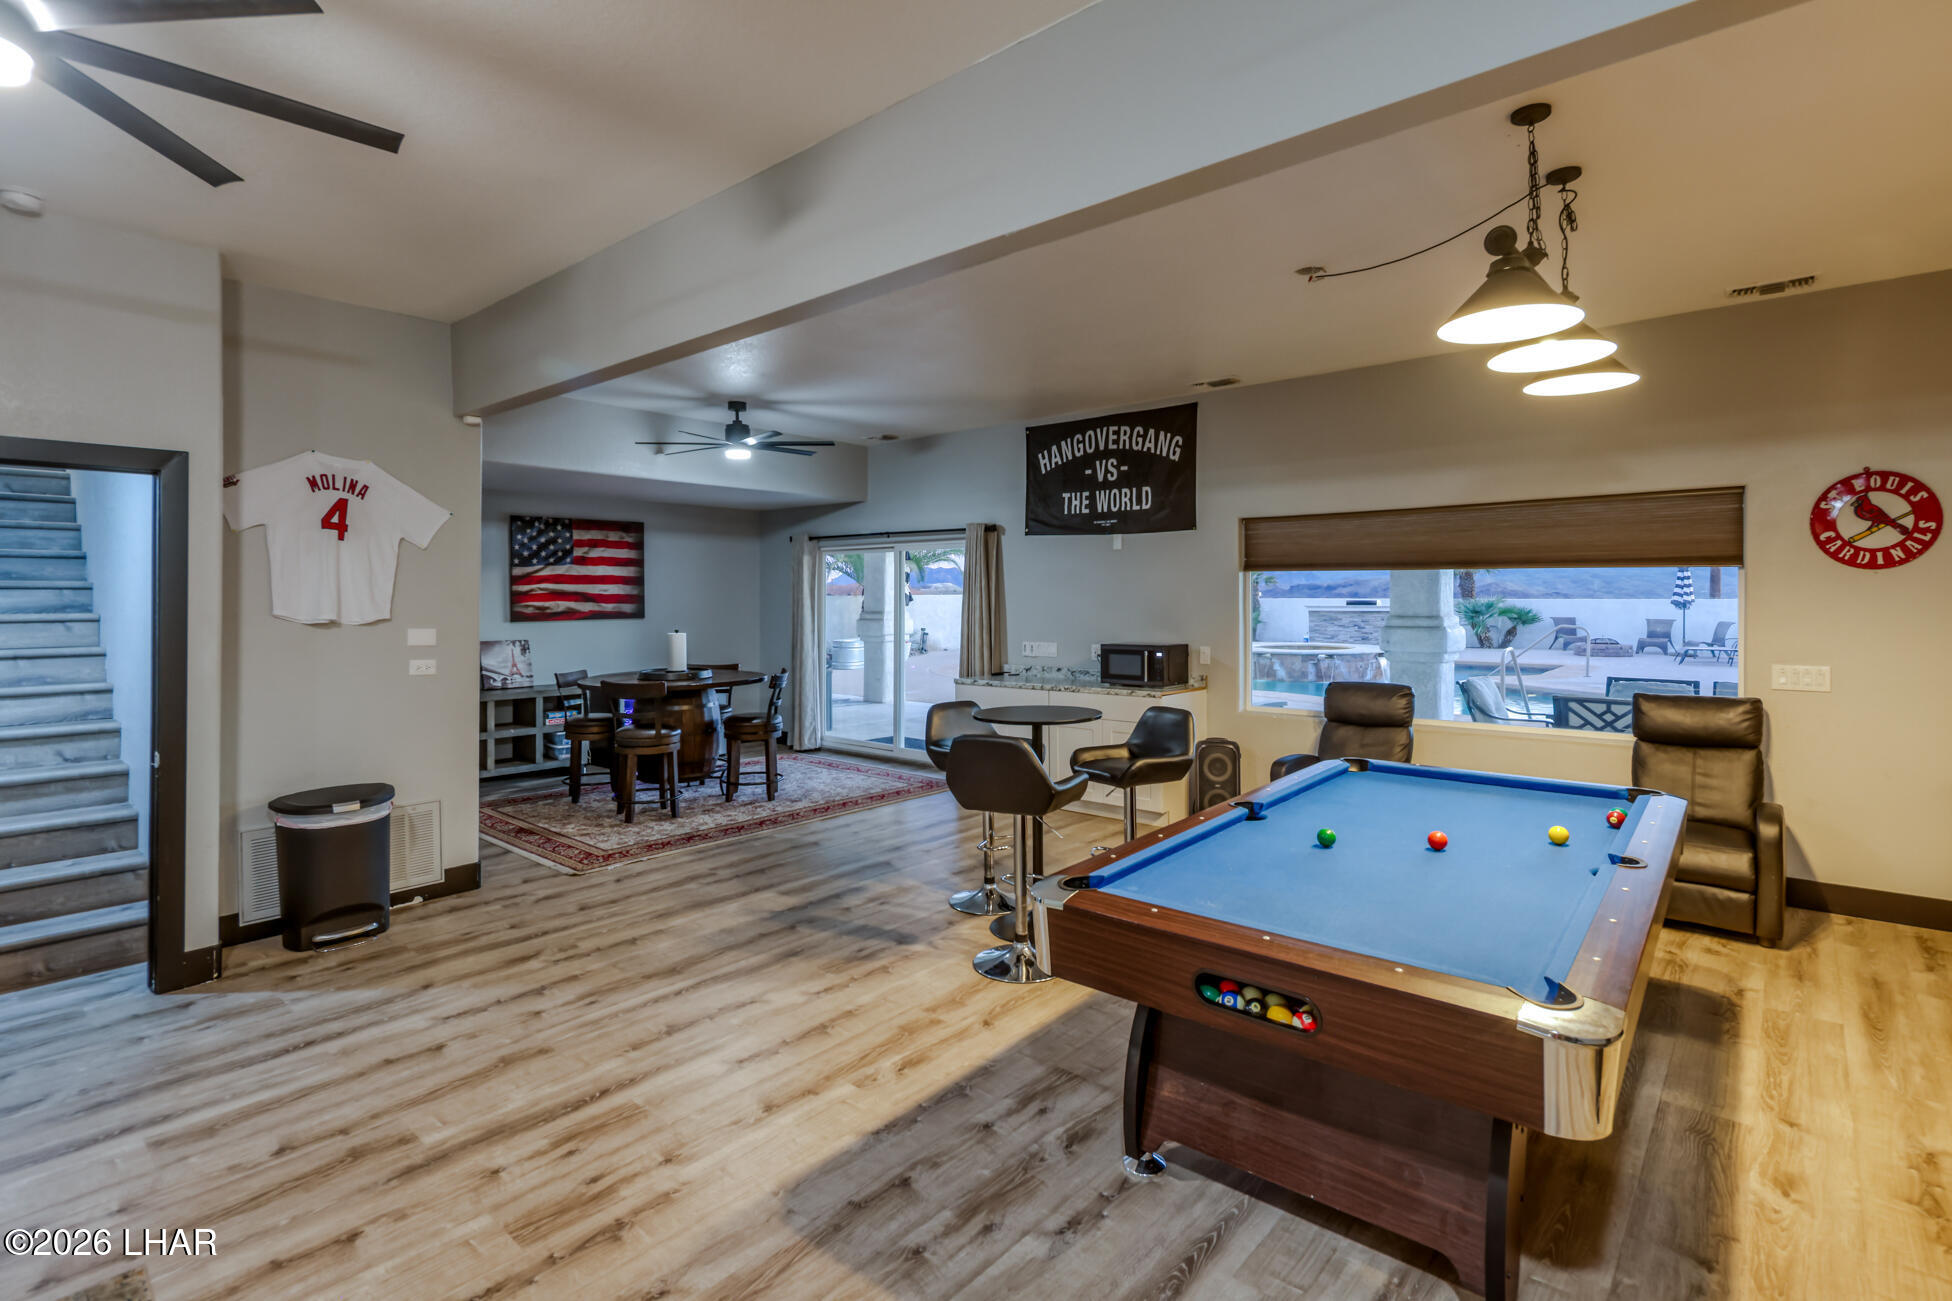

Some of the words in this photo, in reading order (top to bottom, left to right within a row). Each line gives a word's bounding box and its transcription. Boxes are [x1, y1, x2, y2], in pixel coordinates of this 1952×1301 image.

[1038, 425, 1183, 475] HANGOVERGANG
[306, 473, 370, 500] MOLINA
[1062, 491, 1090, 515] THE
[1096, 486, 1152, 513] WORLD
[1851, 475, 1929, 502] LOUIS
[321, 497, 349, 541] 4
[1819, 520, 1937, 565] CARDINALS
